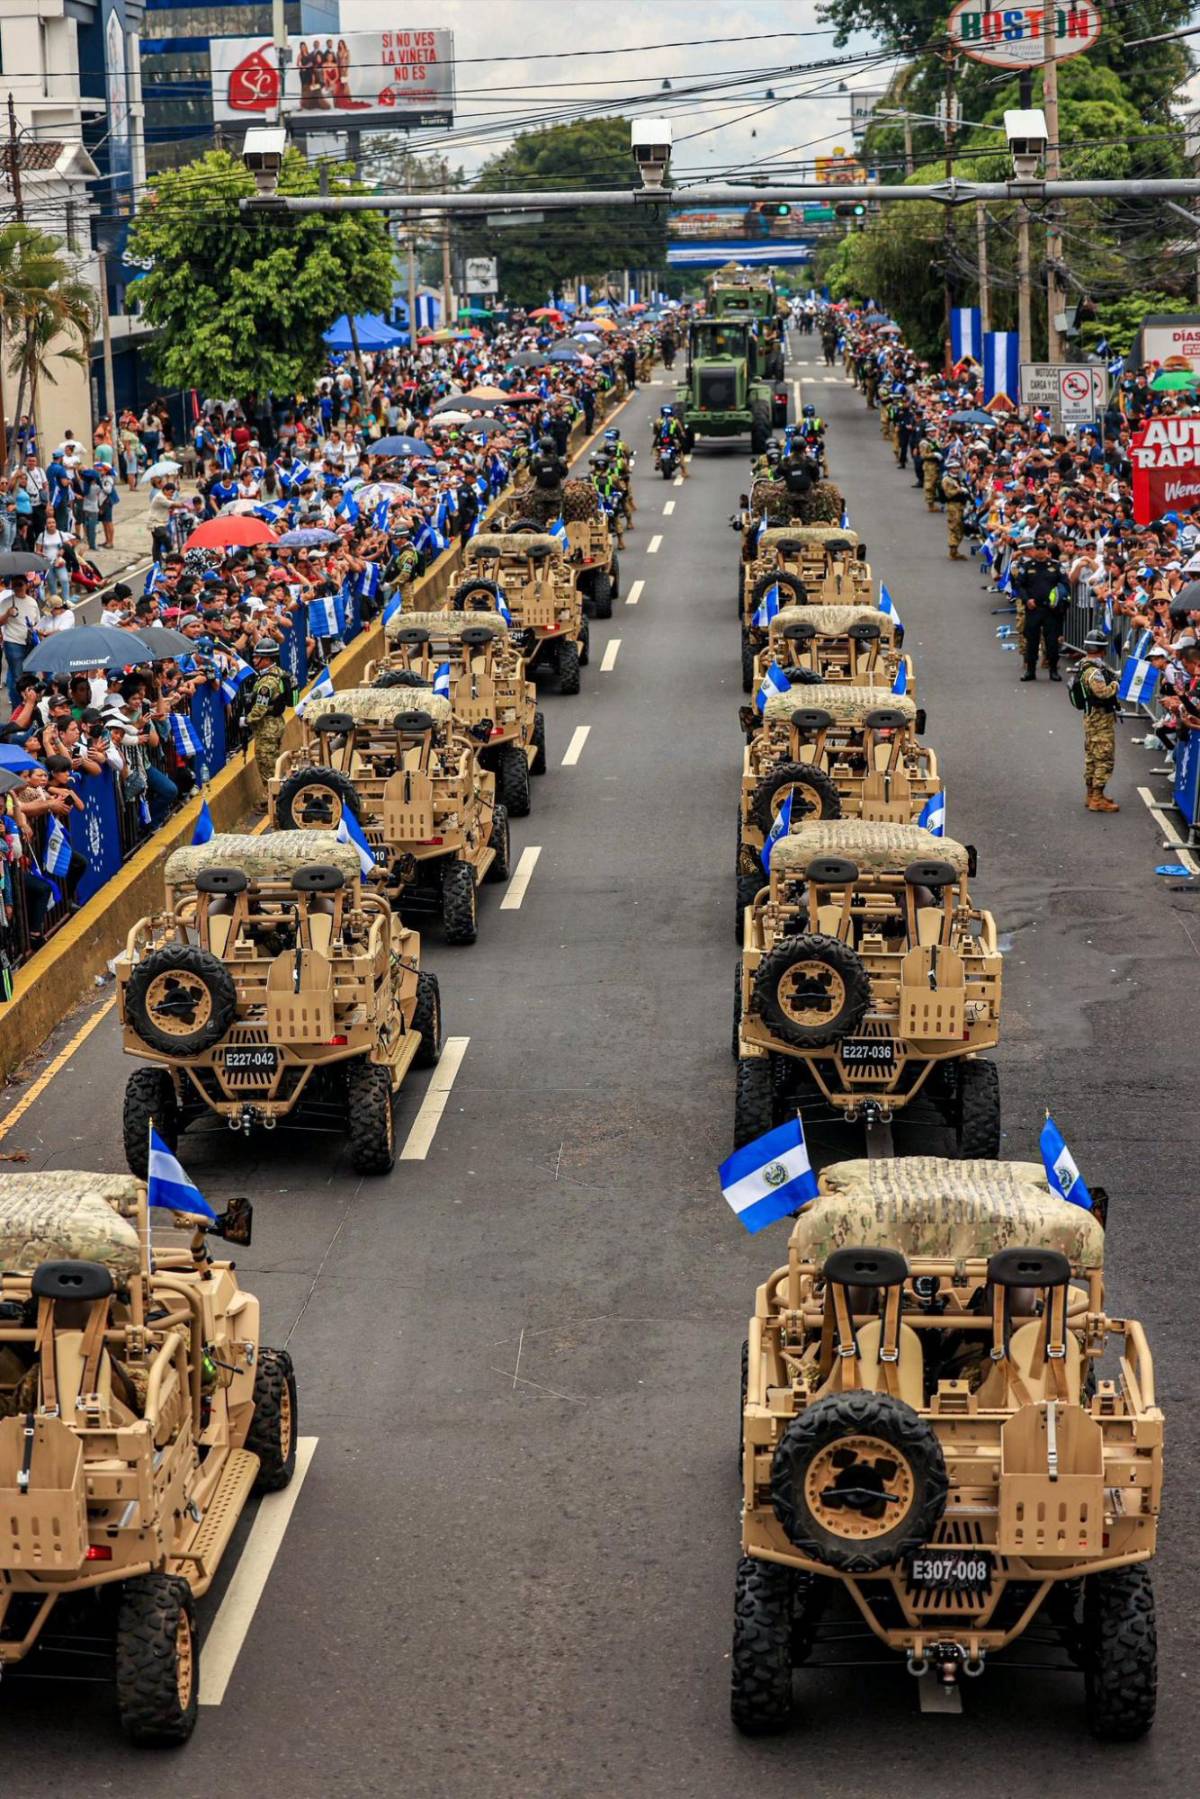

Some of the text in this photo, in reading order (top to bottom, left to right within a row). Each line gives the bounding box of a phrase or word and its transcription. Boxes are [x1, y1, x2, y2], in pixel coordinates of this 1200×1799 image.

[382, 31, 434, 48] SI NO VES
[382, 50, 395, 64] LA
[394, 65, 426, 81] NO ES
[1173, 330, 1200, 341] DÍAS
[843, 1046, 891, 1058] E227-036
[226, 1053, 274, 1066] E227-042
[913, 1561, 986, 1580] E307-008
